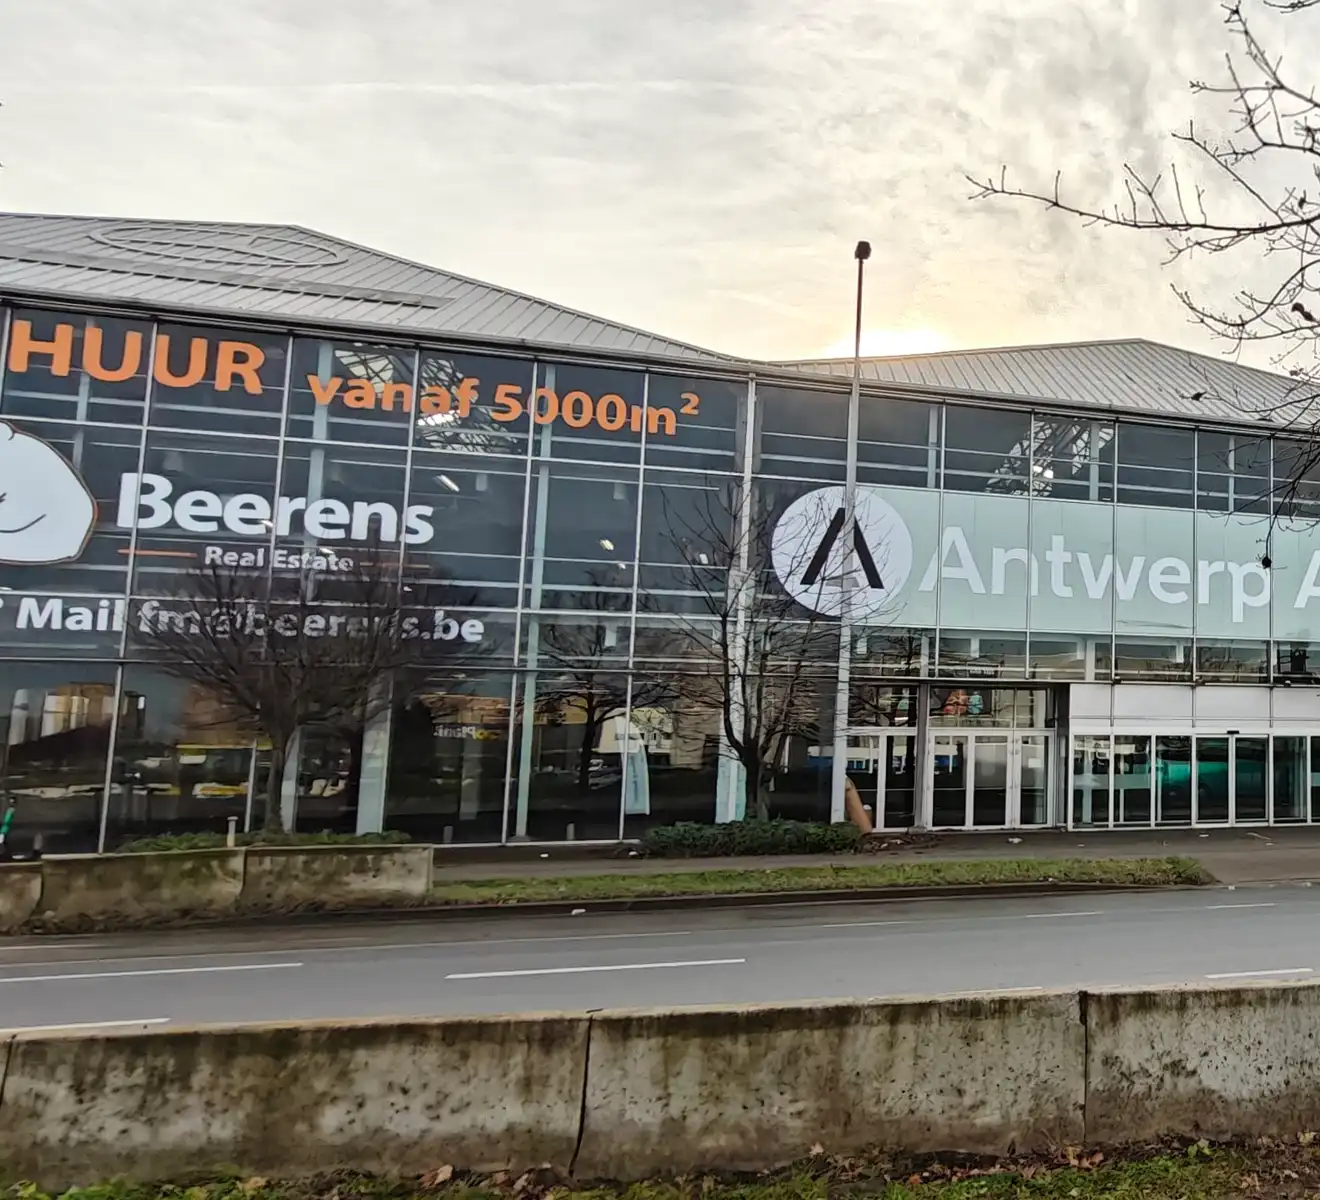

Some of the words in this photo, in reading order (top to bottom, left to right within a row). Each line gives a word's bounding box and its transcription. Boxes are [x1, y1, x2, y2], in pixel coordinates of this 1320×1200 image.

[8, 319, 265, 394] HUUR
[306, 374, 480, 418] vanaf
[117, 472, 434, 545] Beerens
[203, 546, 265, 569] Real
[273, 549, 354, 573] Estate
[918, 525, 1272, 623] Antwerp
[15, 597, 126, 632] Mail
